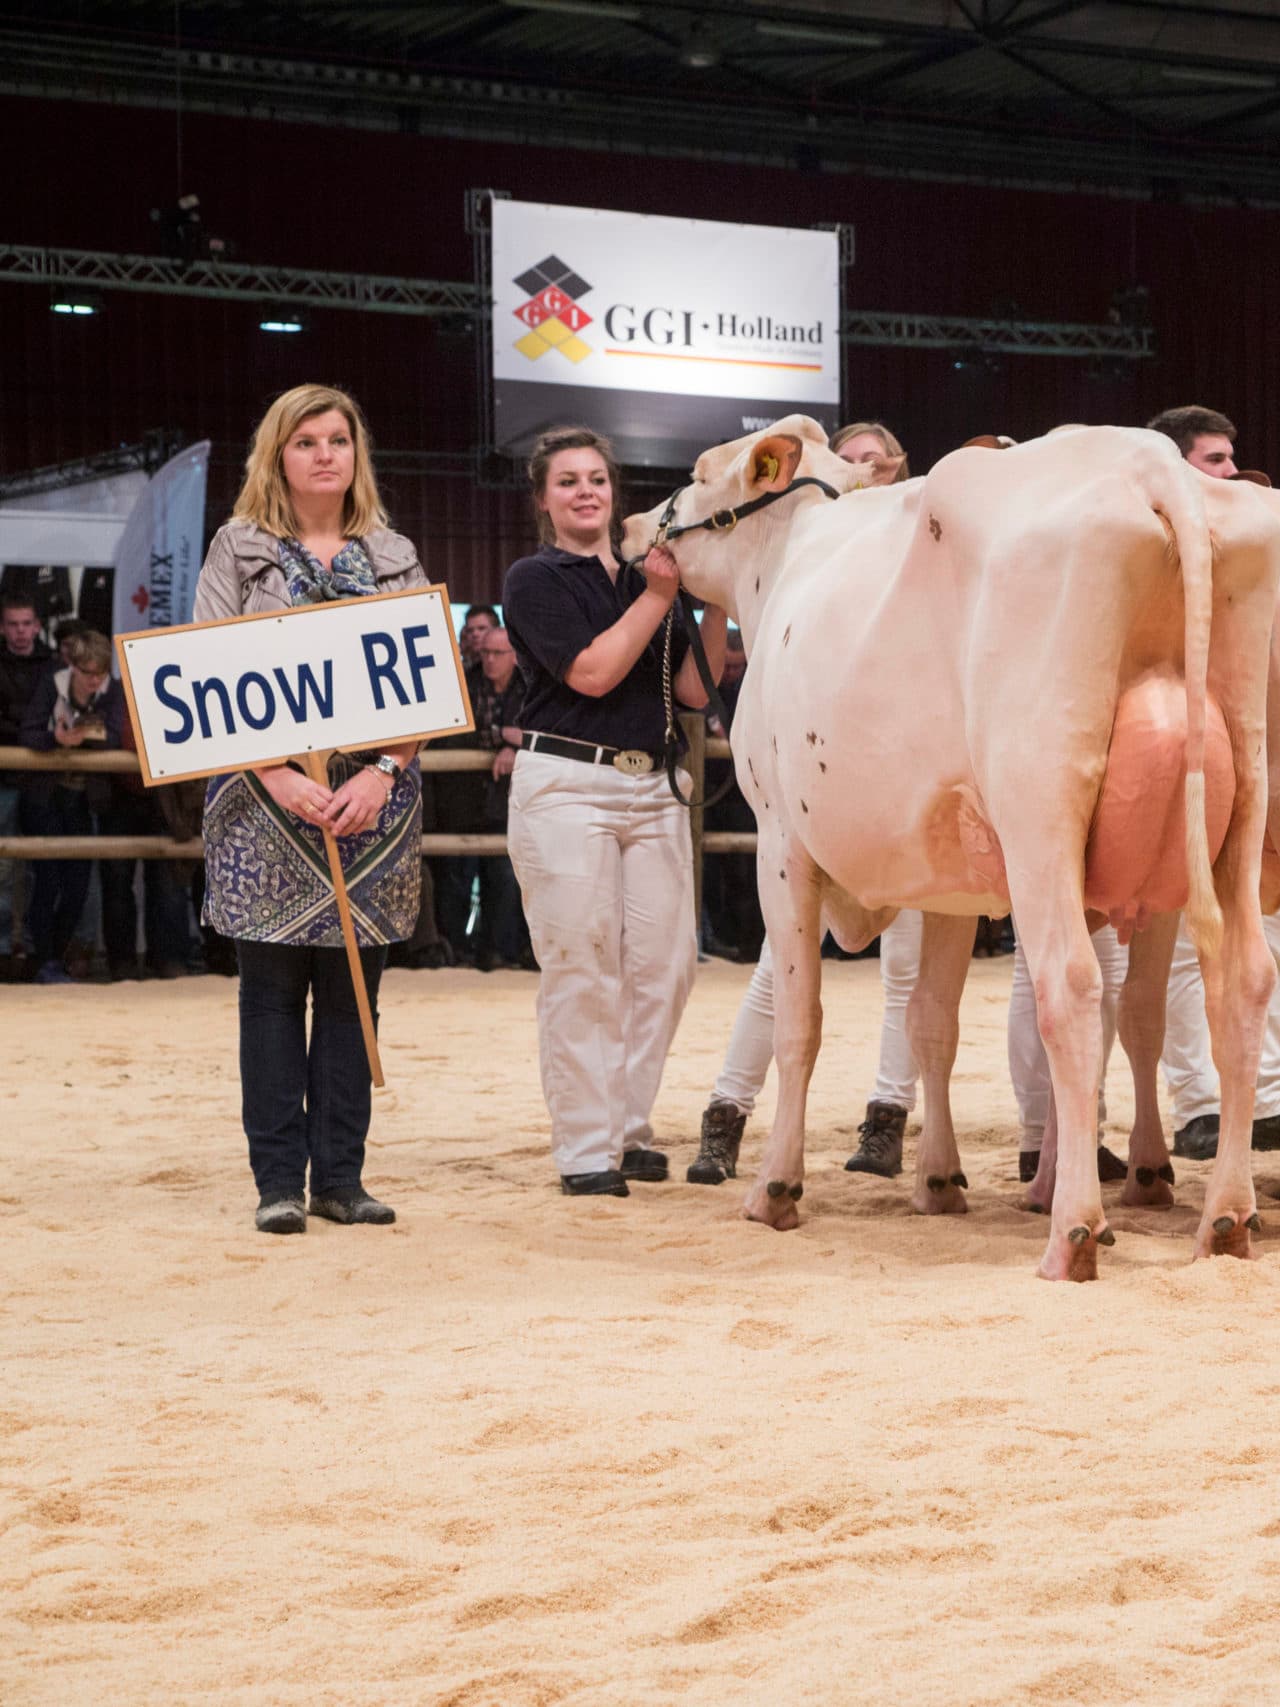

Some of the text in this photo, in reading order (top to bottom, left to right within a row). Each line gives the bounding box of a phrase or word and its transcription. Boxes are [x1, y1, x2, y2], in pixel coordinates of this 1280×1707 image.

[604, 304, 823, 347] GGI Holland
[150, 553, 173, 628] EMEX
[153, 624, 436, 745] Snow RF
